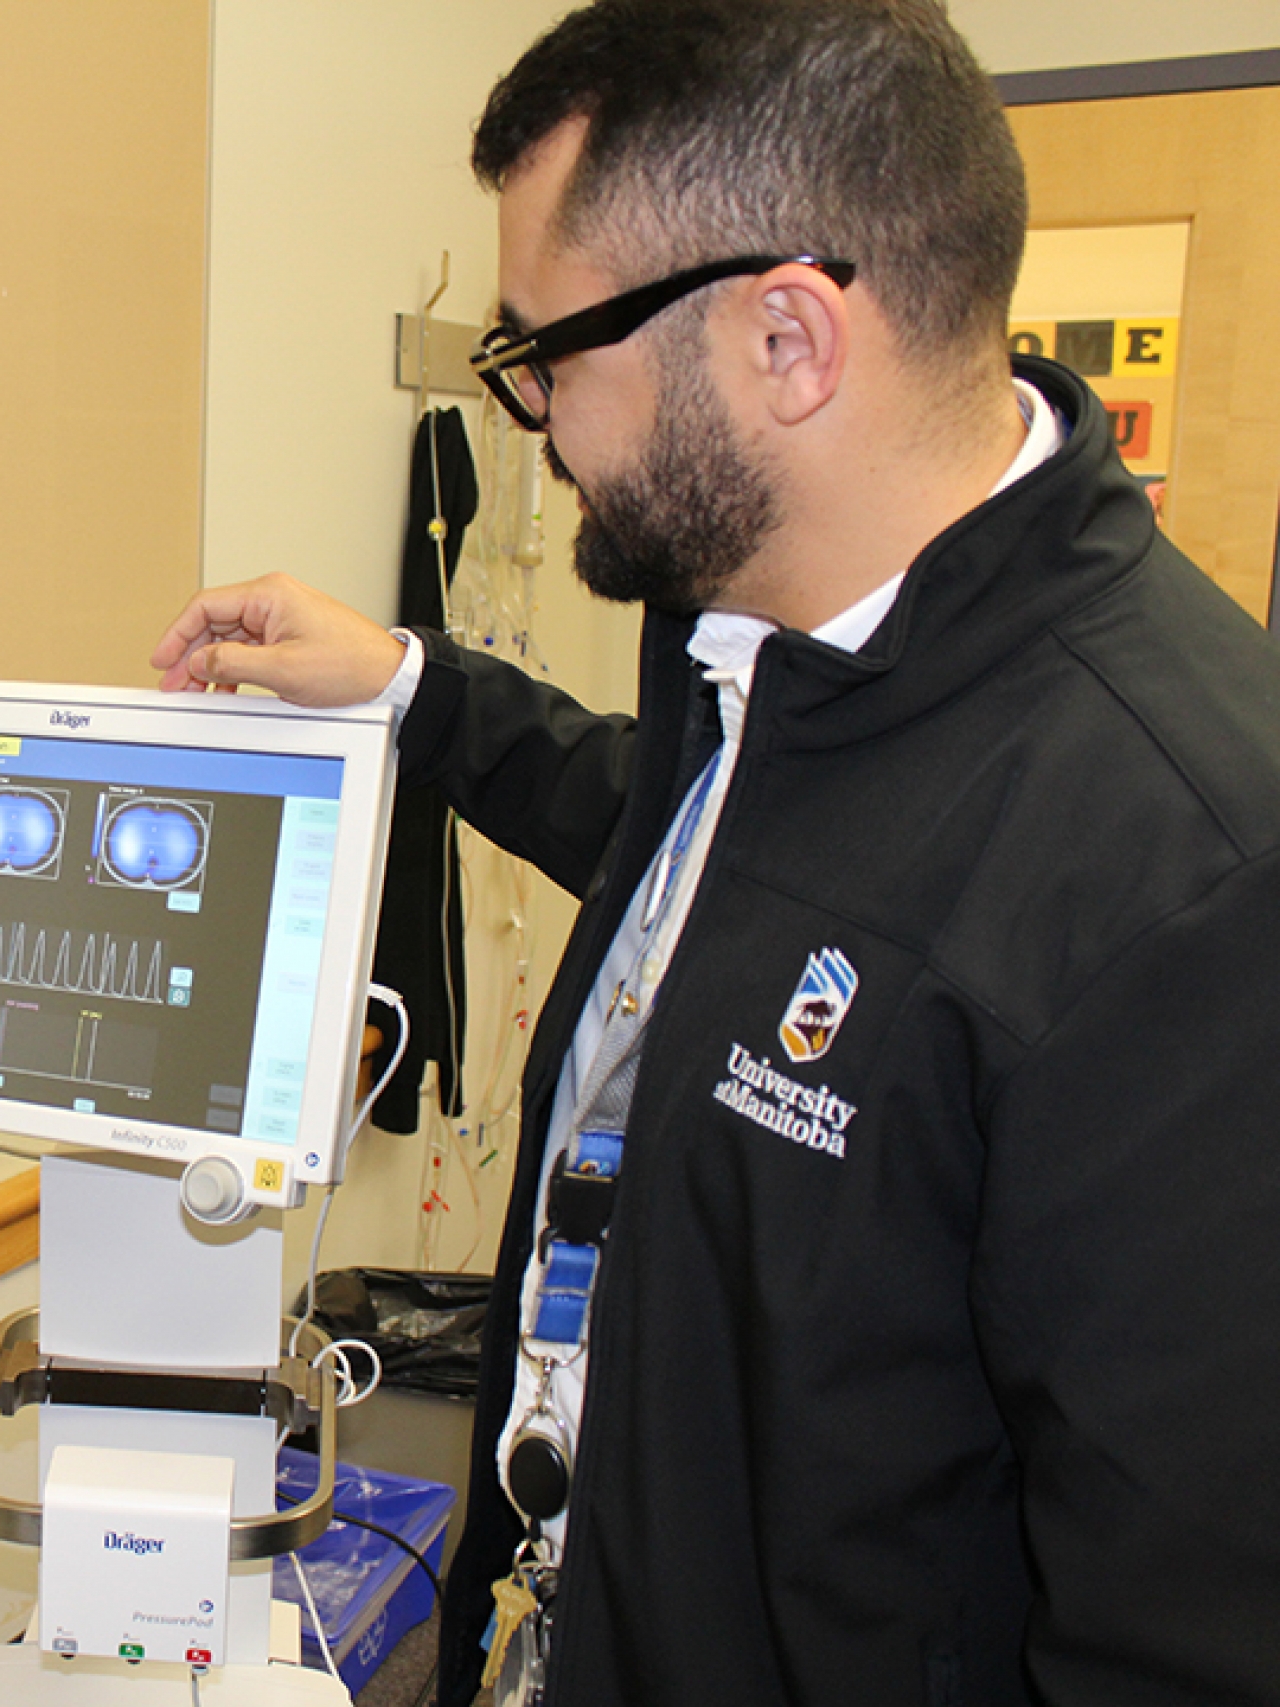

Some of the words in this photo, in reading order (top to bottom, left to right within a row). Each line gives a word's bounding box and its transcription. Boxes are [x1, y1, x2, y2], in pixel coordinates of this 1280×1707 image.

[50, 711, 91, 729] Dräger
[727, 1041, 858, 1131] University
[727, 1078, 846, 1160] Manitoba
[111, 1128, 154, 1148] Infinity
[104, 1531, 166, 1555] Dräger
